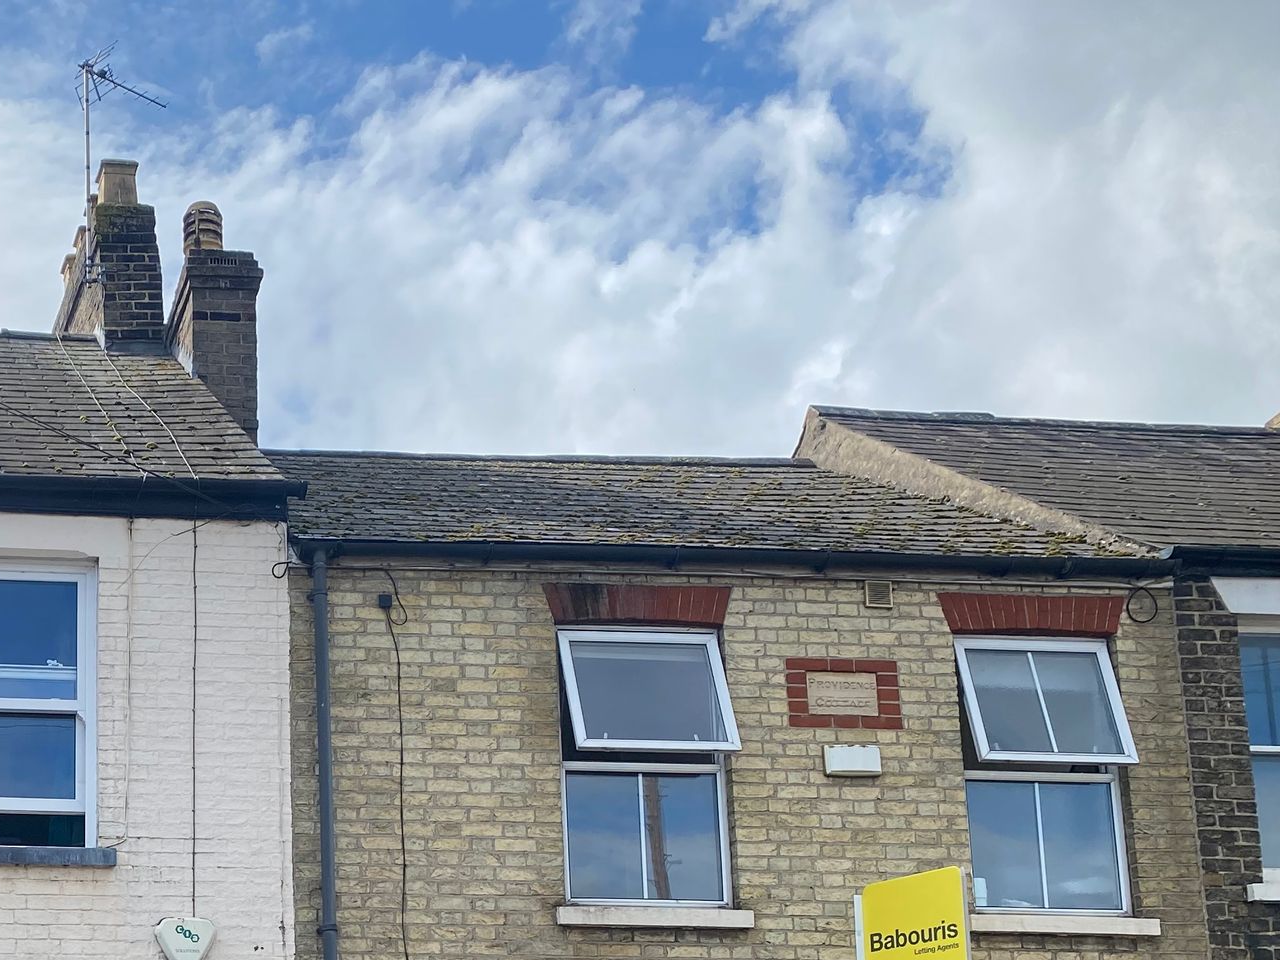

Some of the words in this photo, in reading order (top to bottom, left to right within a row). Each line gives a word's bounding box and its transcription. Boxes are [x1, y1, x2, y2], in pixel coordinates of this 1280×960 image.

[808, 677, 876, 690] PROVIDENCE
[870, 920, 959, 952] Babouris
[914, 946, 936, 955] Letting
[937, 942, 959, 952] Agents
